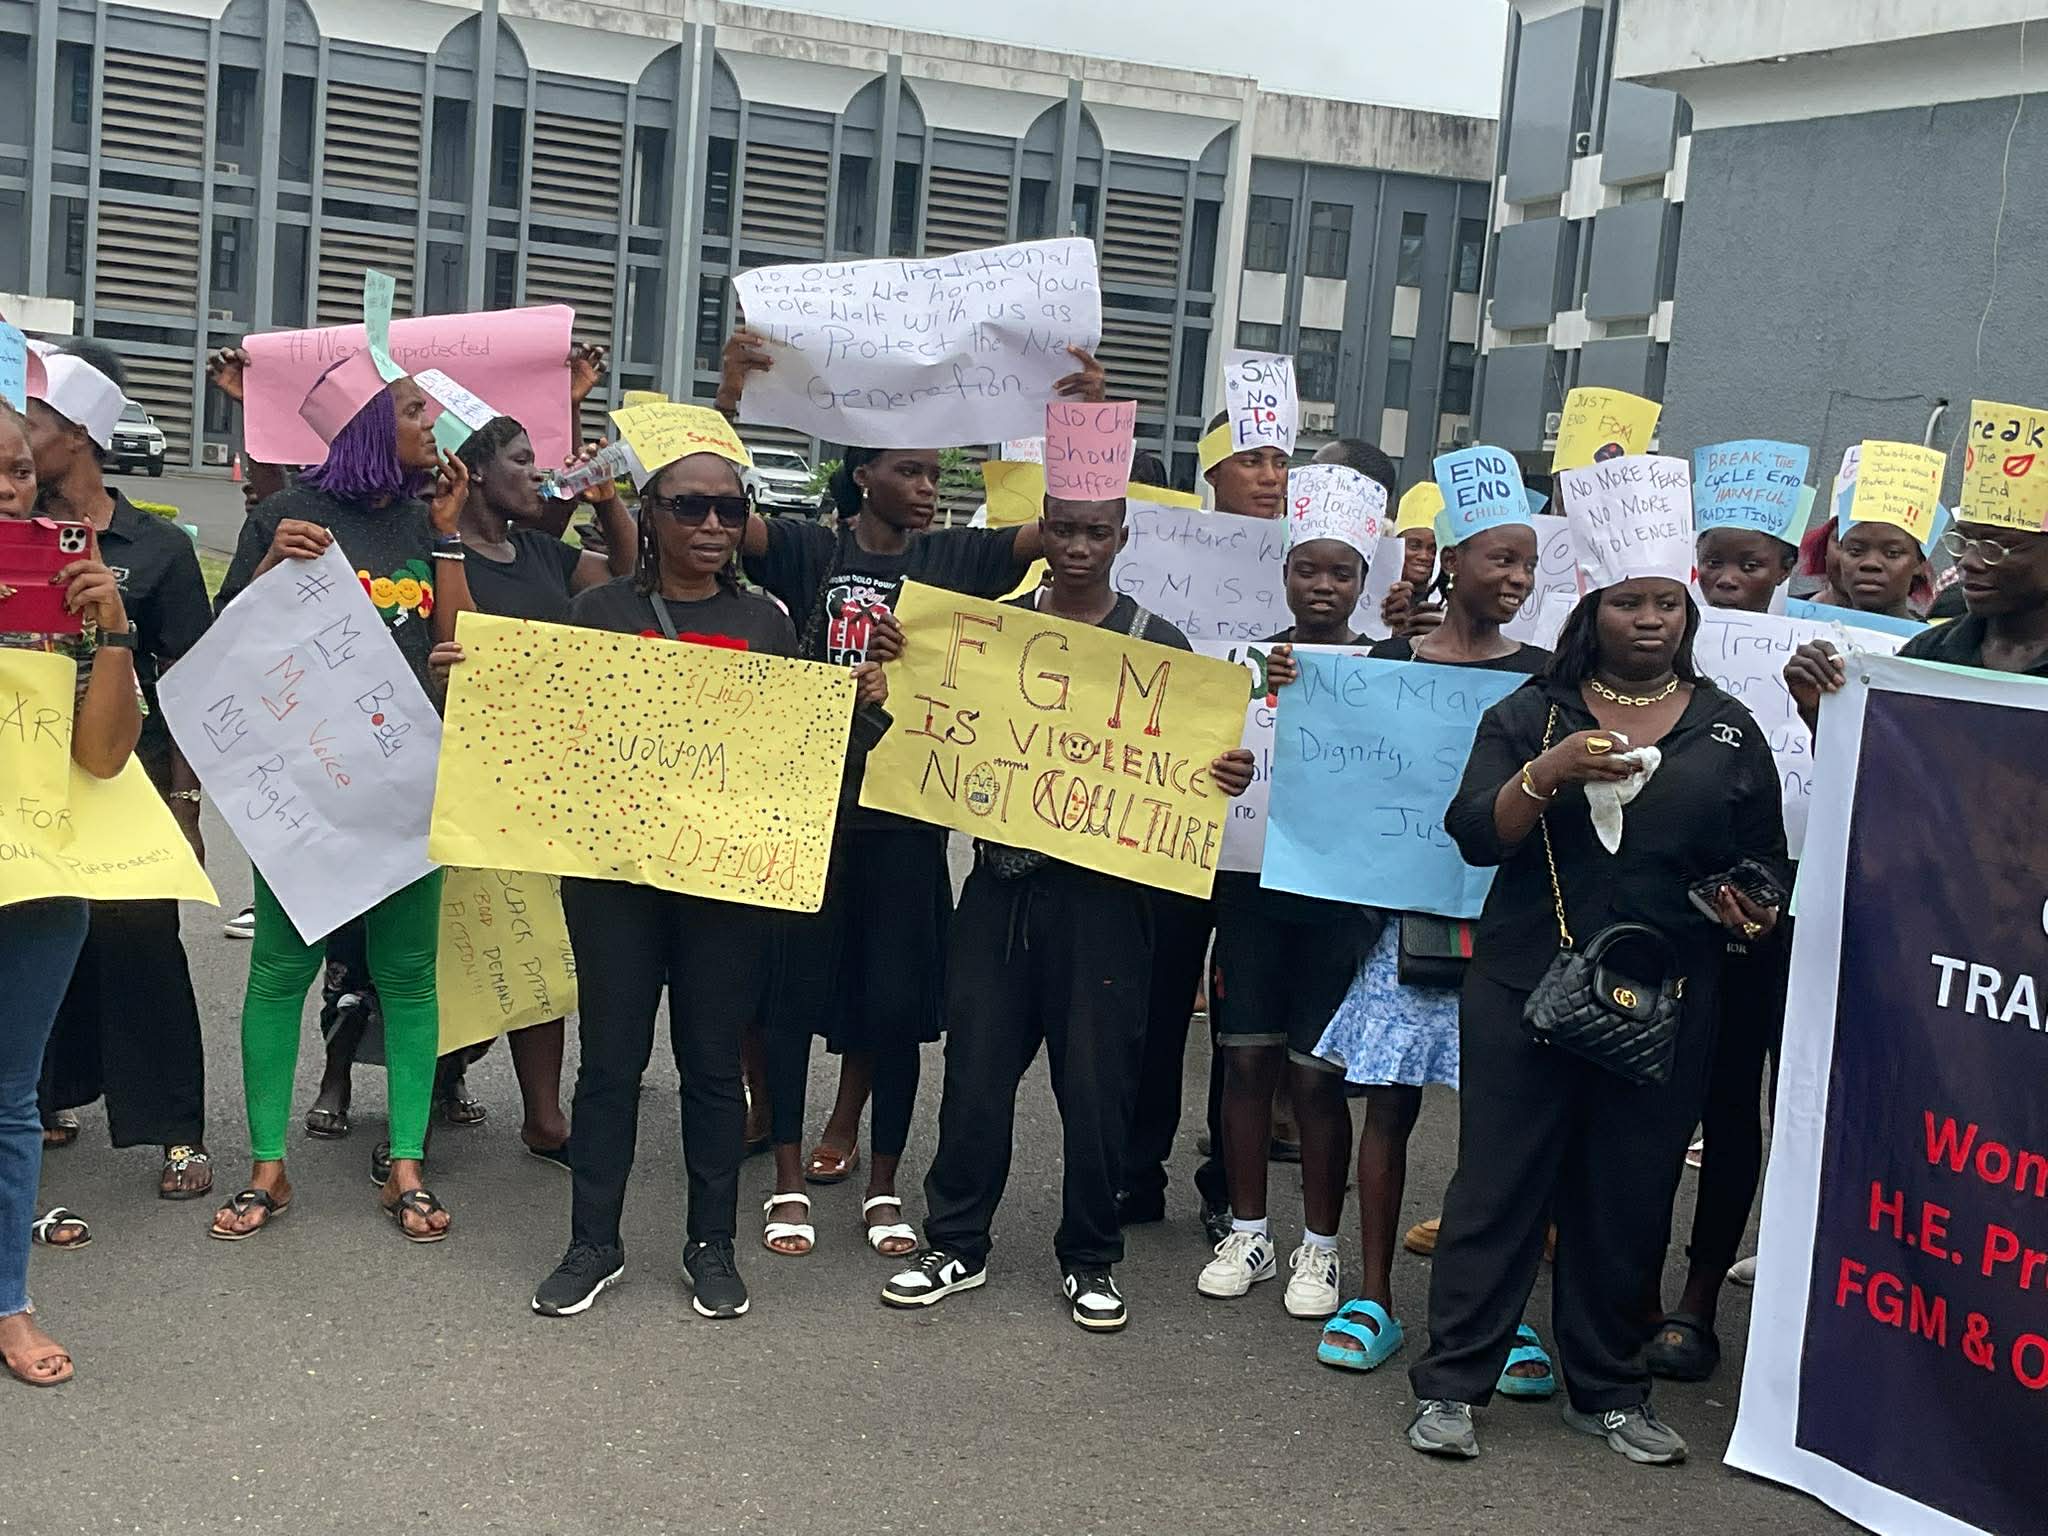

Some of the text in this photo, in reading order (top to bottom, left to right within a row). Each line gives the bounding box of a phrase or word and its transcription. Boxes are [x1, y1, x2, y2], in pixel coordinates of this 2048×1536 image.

[884, 246, 1071, 284] Traditional
[929, 277, 1014, 305] honor
[1027, 270, 1094, 300] Your
[765, 297, 1073, 333] role Walk with us as
[820, 324, 956, 368] Protect
[967, 322, 1001, 353] the
[1242, 358, 1290, 401] SAY
[1574, 393, 1612, 410] JUST
[1239, 419, 1290, 445] FGM
[1047, 435, 1128, 465] Should
[1707, 451, 1763, 473] BREAK
[1975, 444, 1997, 464] The
[1048, 466, 1122, 496] Suffer
[1296, 470, 1329, 494] Pass
[1450, 456, 1508, 485] END
[1595, 464, 1643, 491] MORE
[1979, 476, 2010, 498] End
[1457, 479, 1511, 509] END
[1620, 494, 1673, 519] MORE
[1129, 510, 1248, 551] Future
[1300, 516, 1331, 532] and
[1463, 504, 1510, 523] CHILD
[829, 618, 871, 651] EN
[1217, 621, 1264, 640] rise
[1295, 652, 1369, 708] We
[1395, 675, 1492, 713] Mar
[904, 693, 981, 746] IS
[308, 717, 352, 790] Voice
[618, 734, 728, 793] Women
[246, 753, 310, 832] Right
[16, 796, 73, 832] FOR
[1374, 806, 1452, 849] Jus
[656, 825, 800, 892] PROTECT
[482, 944, 516, 1016] DEMAND
[1930, 953, 2048, 1034] TRA
[1868, 1180, 2048, 1291] H.E. Pr
[1835, 1256, 1947, 1349] FGM
[1961, 1310, 1996, 1373] &
